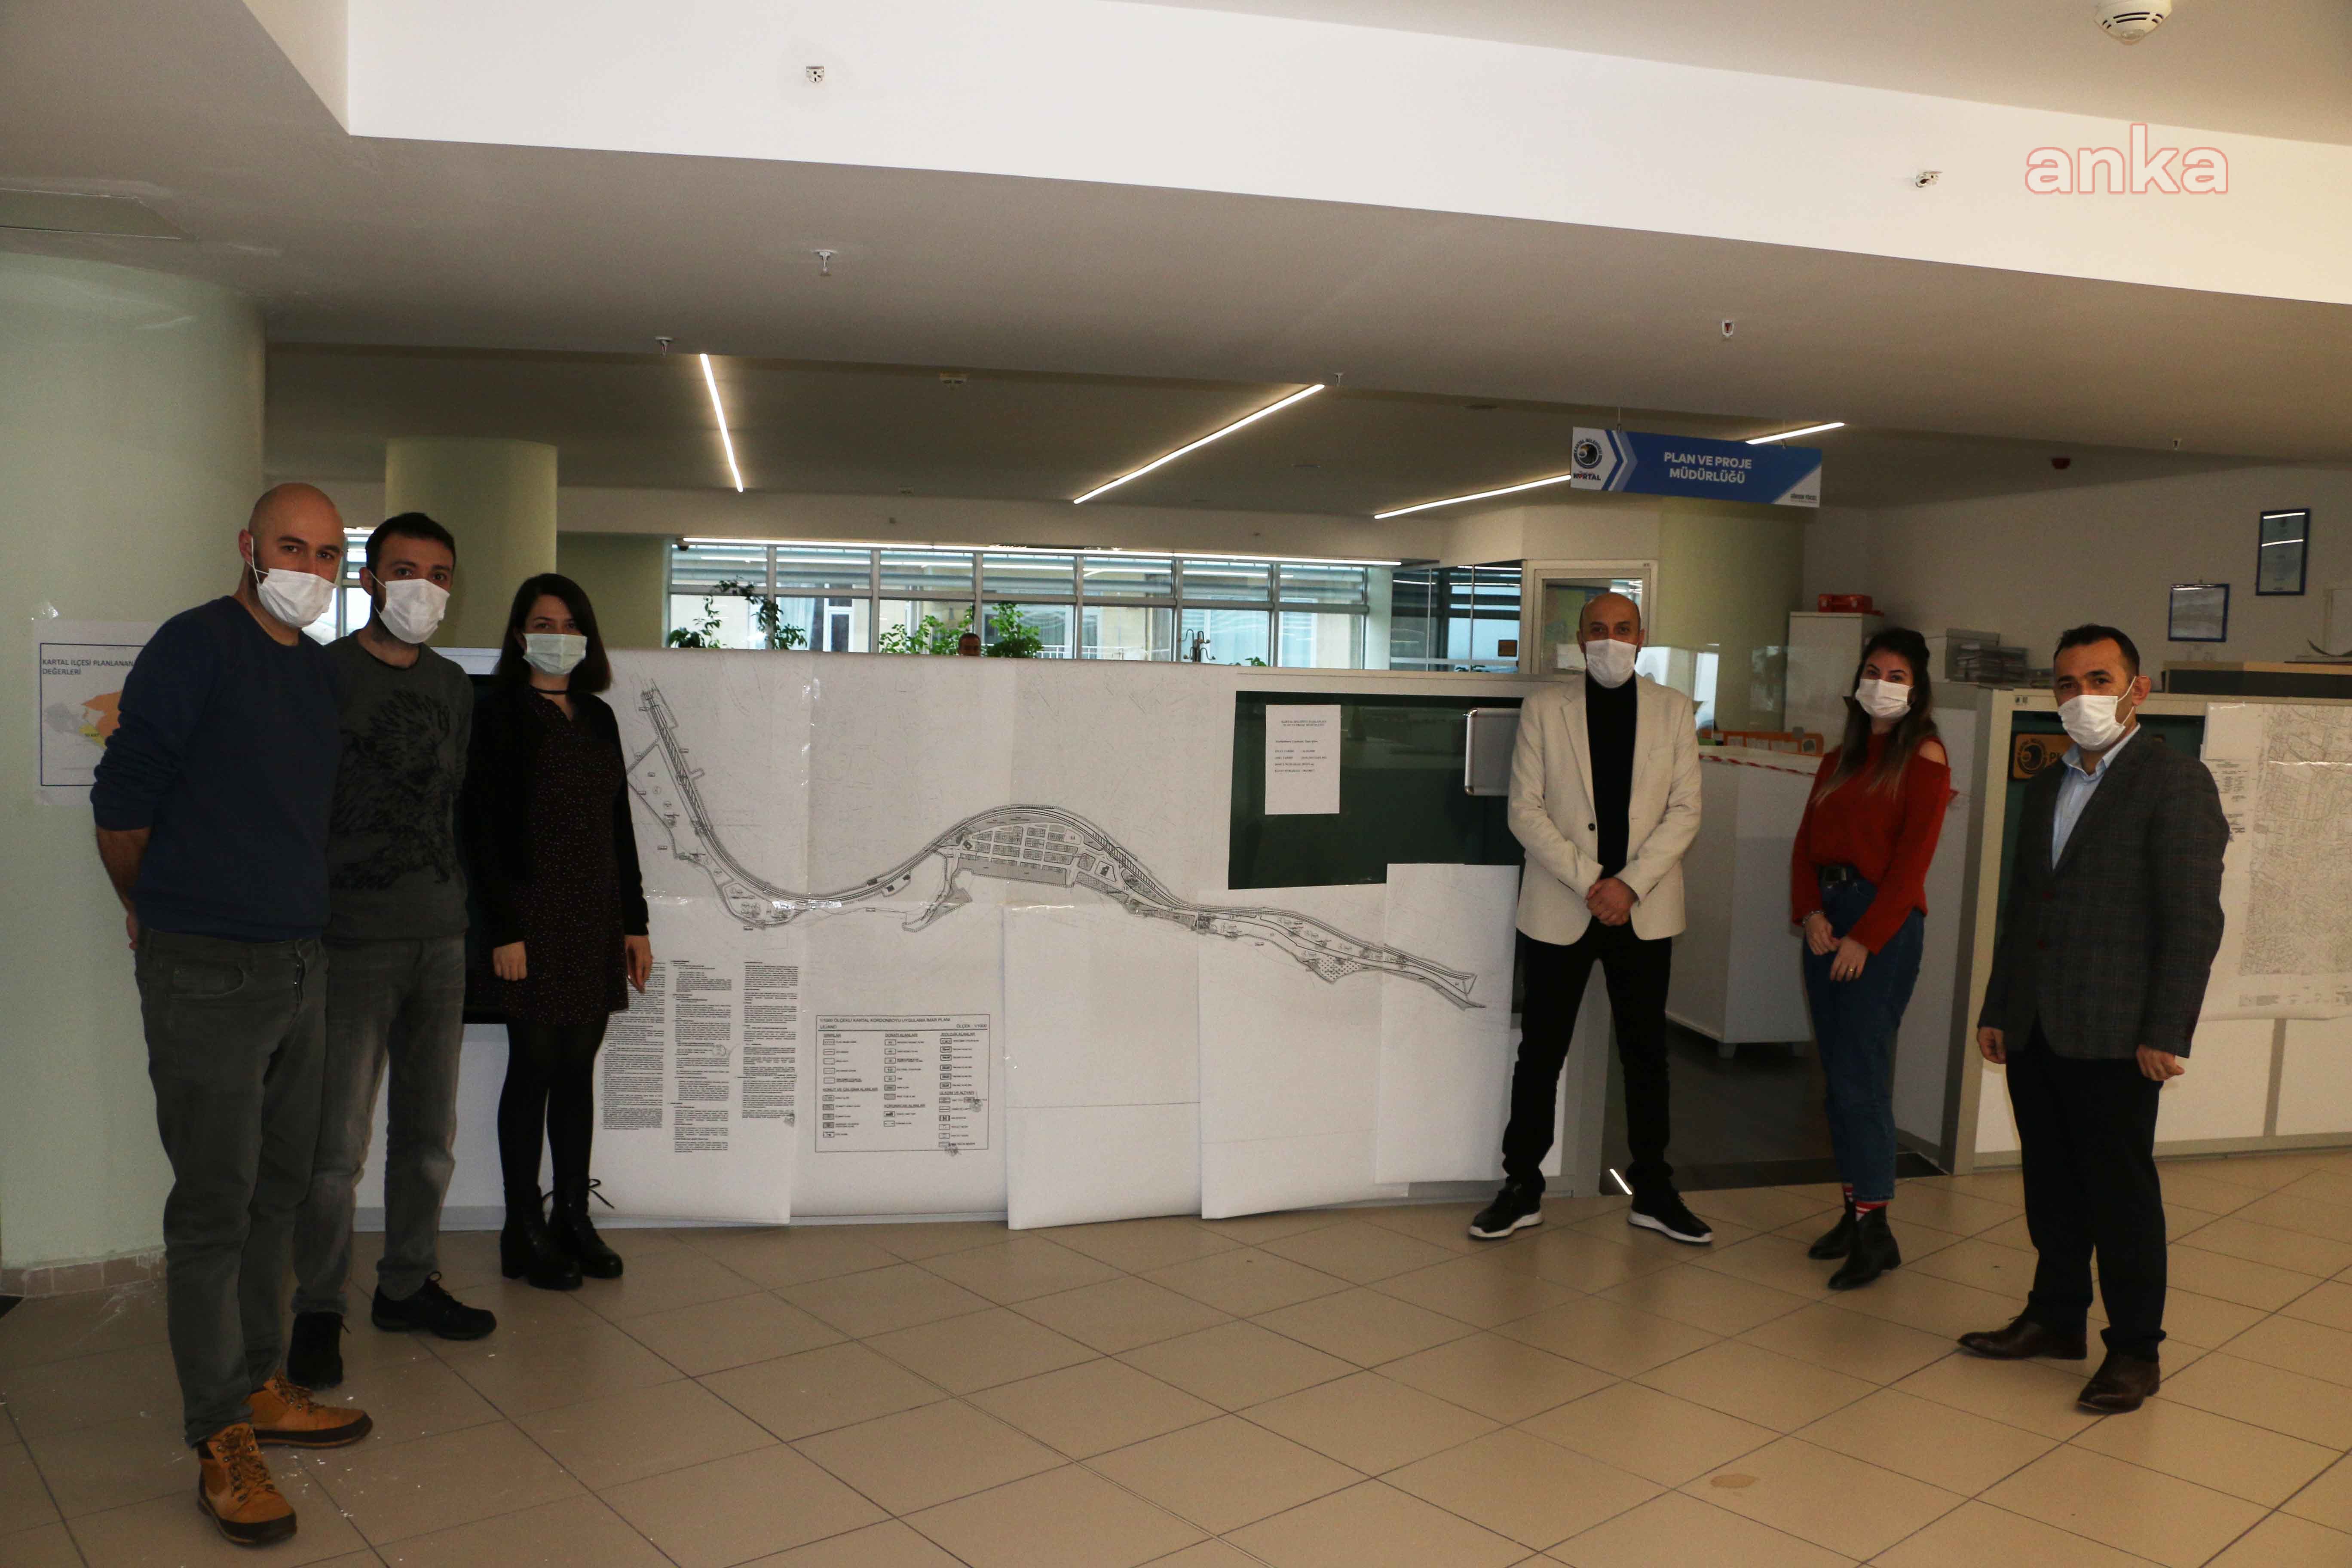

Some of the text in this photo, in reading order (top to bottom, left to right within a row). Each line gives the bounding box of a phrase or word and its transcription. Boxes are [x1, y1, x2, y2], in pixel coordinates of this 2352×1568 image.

[1664, 452, 1752, 469] PLAN VE PROJE
[1669, 466, 1745, 484] MÜDÜRLÜĞÜ
